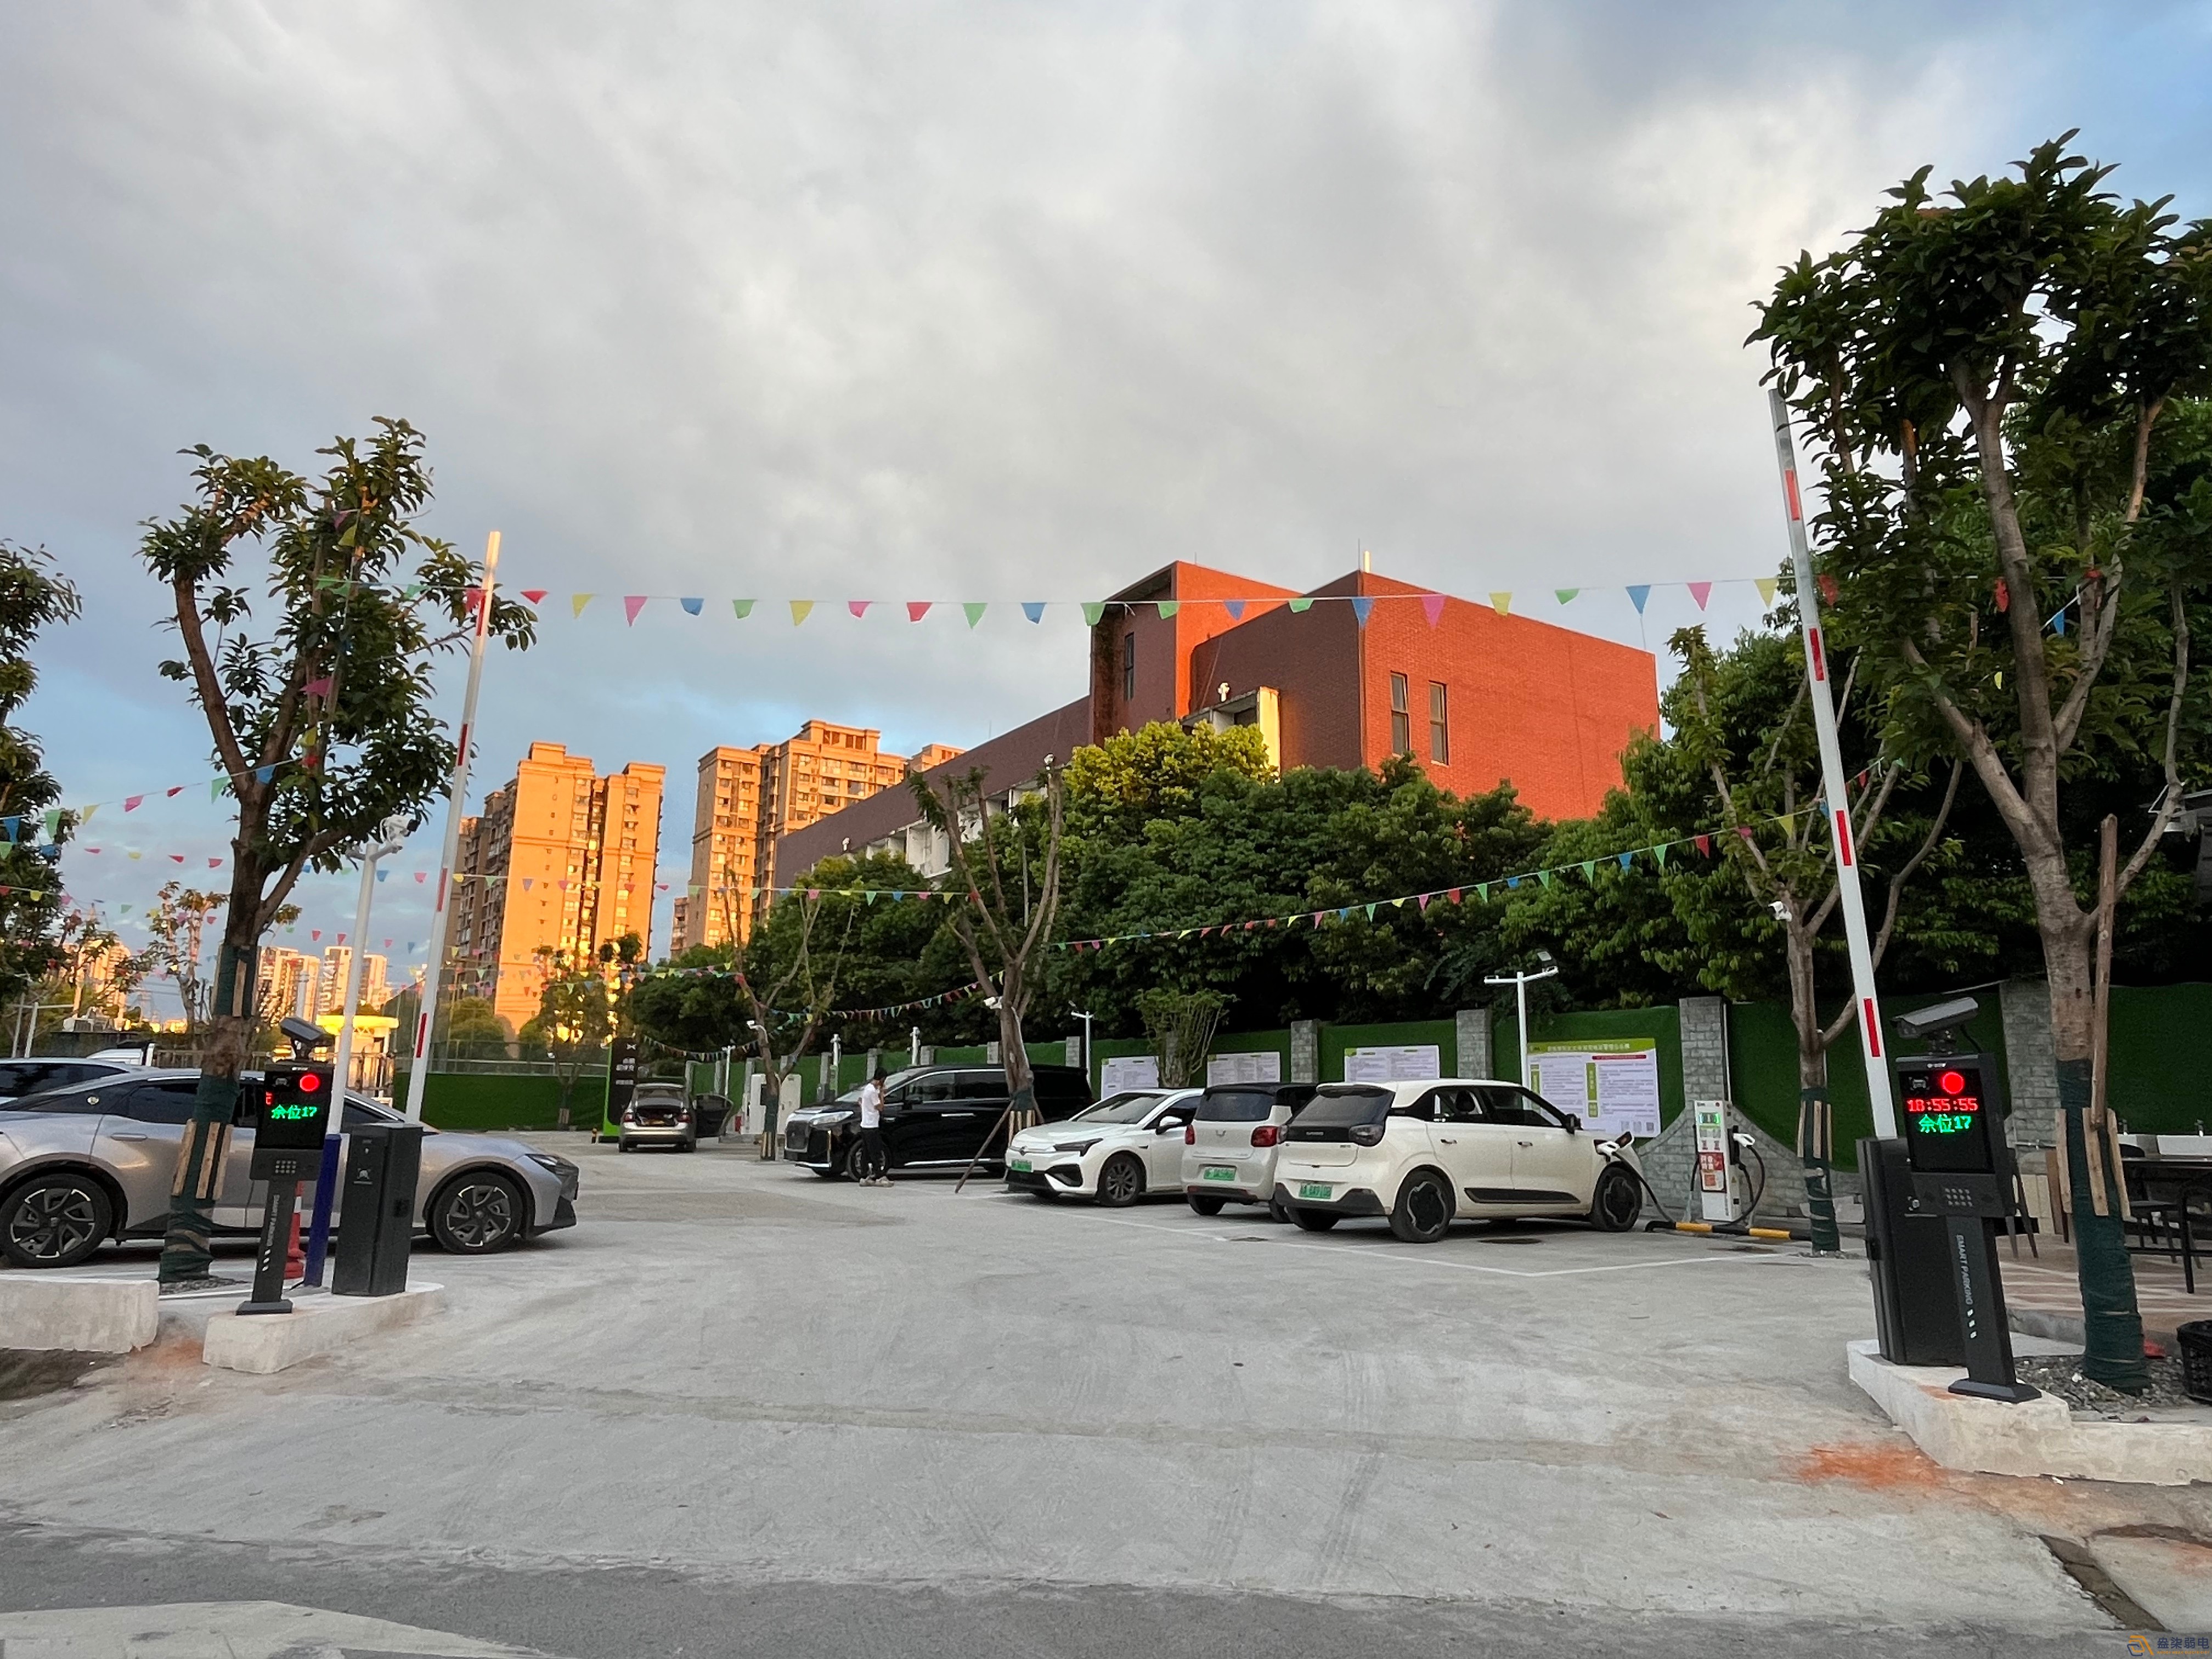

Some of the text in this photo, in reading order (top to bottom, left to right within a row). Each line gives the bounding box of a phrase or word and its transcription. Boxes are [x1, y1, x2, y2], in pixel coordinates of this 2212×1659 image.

[272, 1104, 317, 1119] 余位17
[1907, 1098, 1978, 1111] 18:55:55
[1919, 1114, 1971, 1133] 余位17
